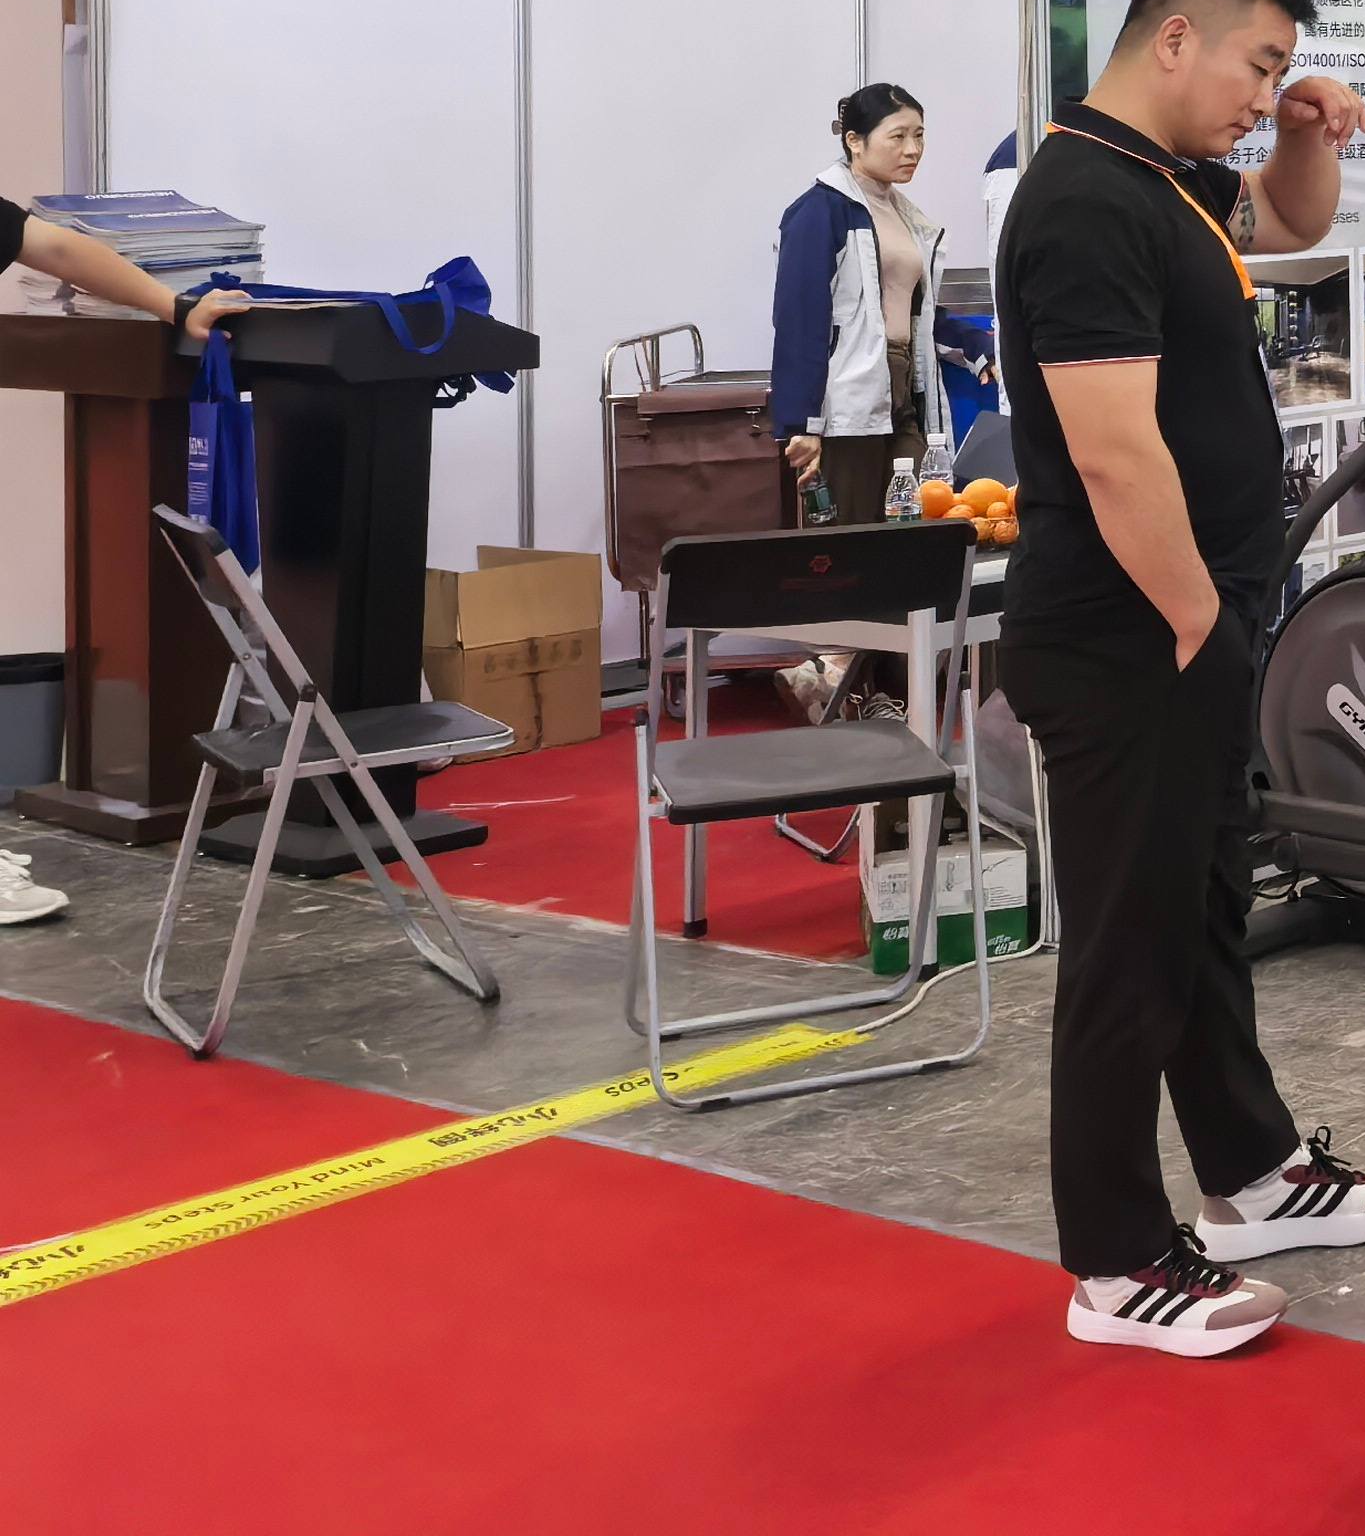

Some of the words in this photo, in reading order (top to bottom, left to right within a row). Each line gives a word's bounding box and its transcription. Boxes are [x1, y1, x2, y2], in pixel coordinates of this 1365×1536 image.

[310, 1157, 385, 1184] Mind
[241, 1180, 310, 1204] Your
[144, 1200, 234, 1230] Steps
